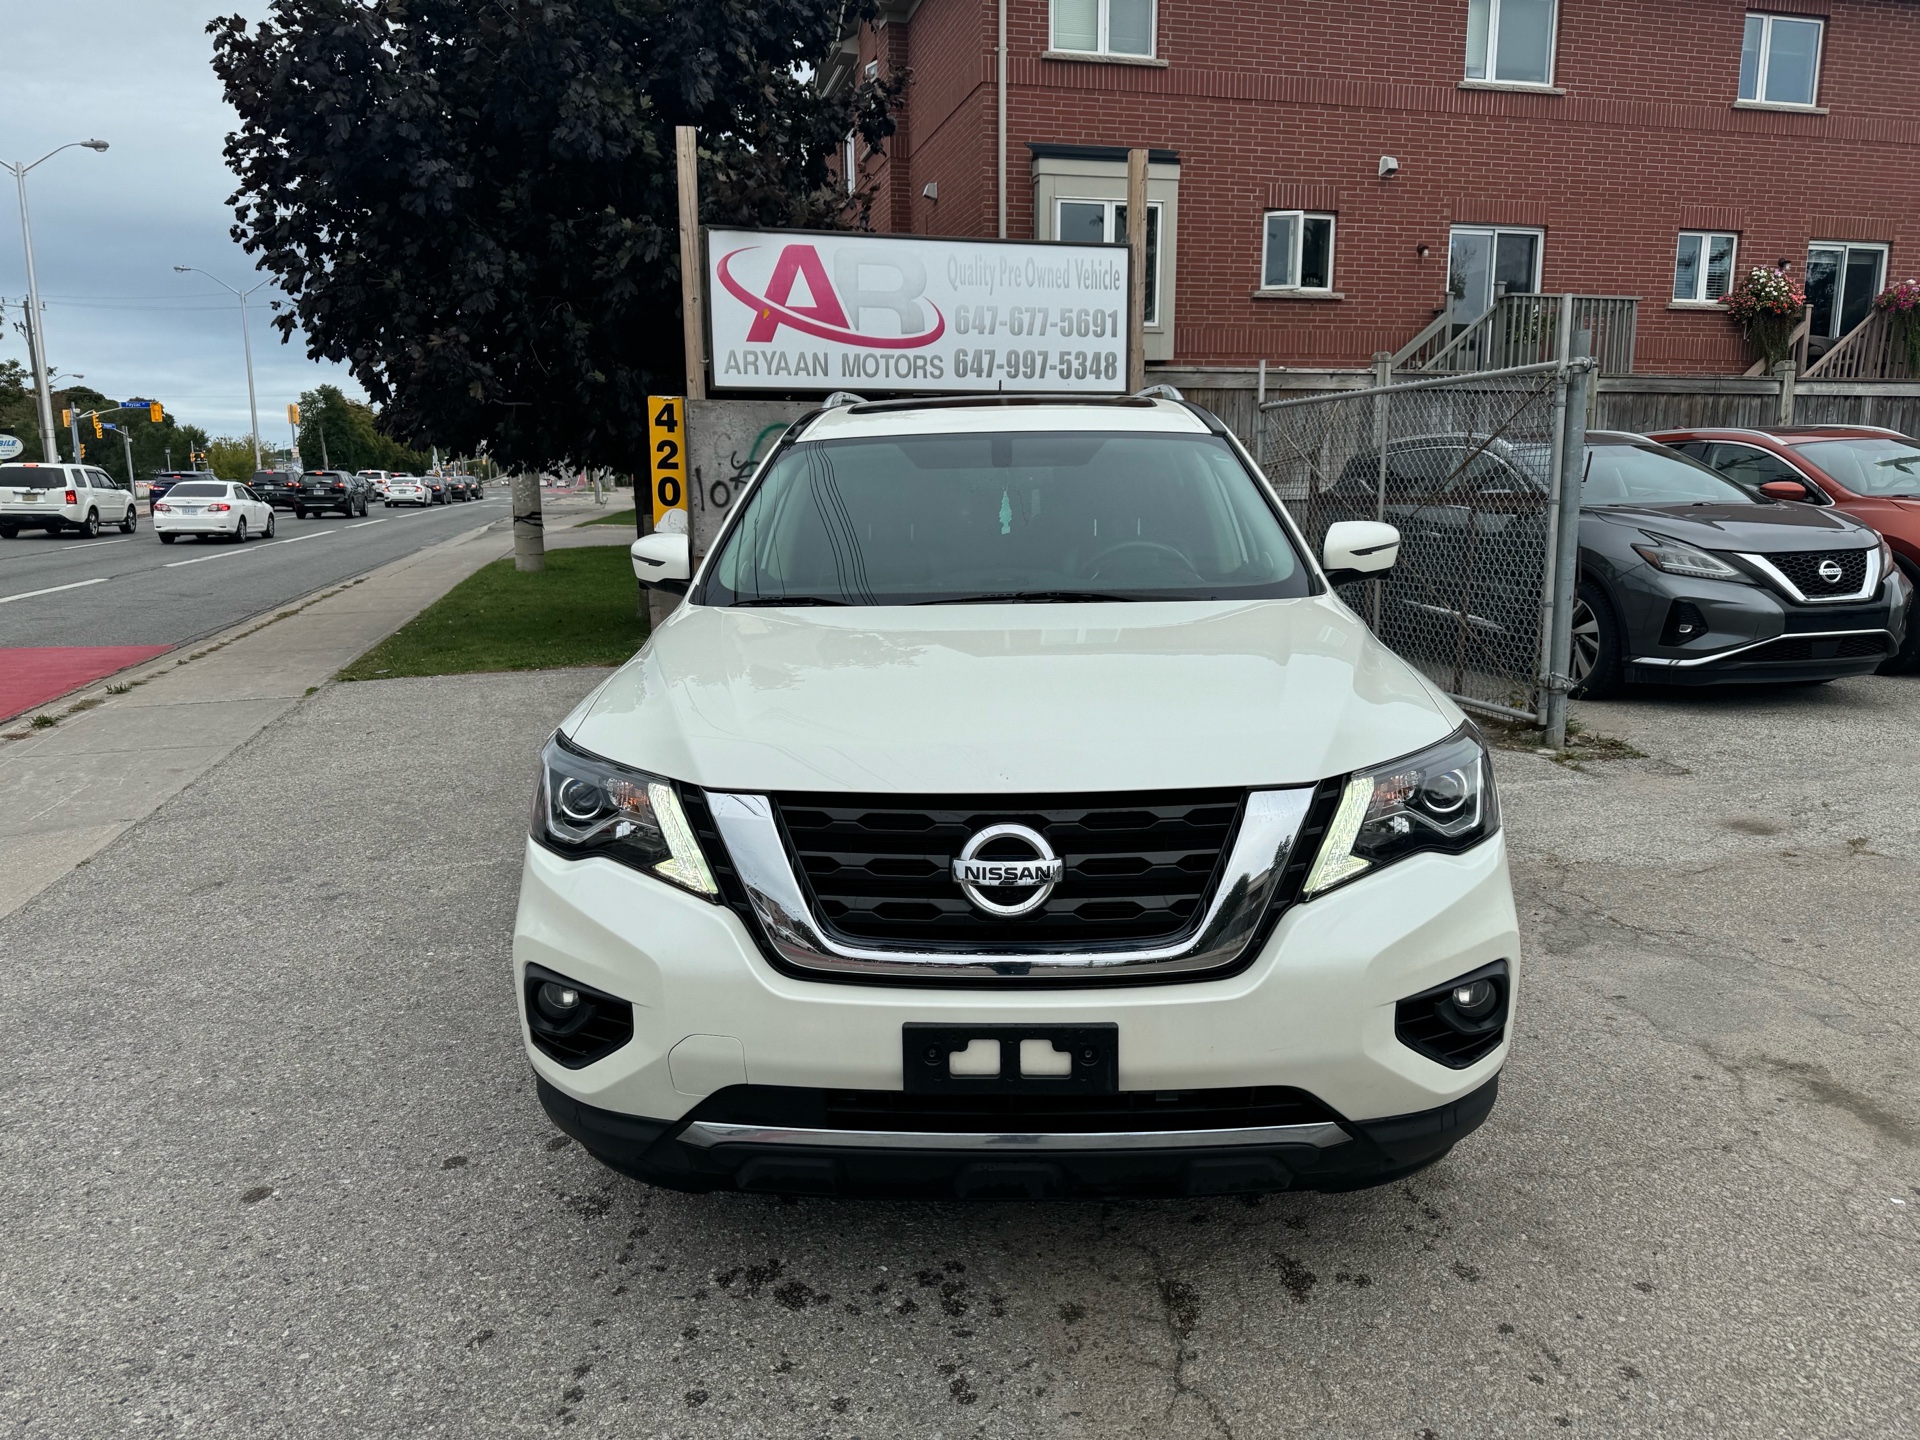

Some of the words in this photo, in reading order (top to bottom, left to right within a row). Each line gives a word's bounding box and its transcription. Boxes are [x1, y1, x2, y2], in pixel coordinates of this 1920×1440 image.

[947, 253, 996, 296] Quality
[1000, 255, 1022, 288] Pre
[1025, 256, 1070, 289] Owned
[1075, 258, 1120, 291] Vehicle
[954, 304, 1118, 338] 647-677-5691
[724, 349, 829, 377] ARYAAN
[841, 352, 944, 379] MOTORS
[954, 348, 1118, 380] 647-997-5348
[964, 865, 1052, 881] NISSAN
